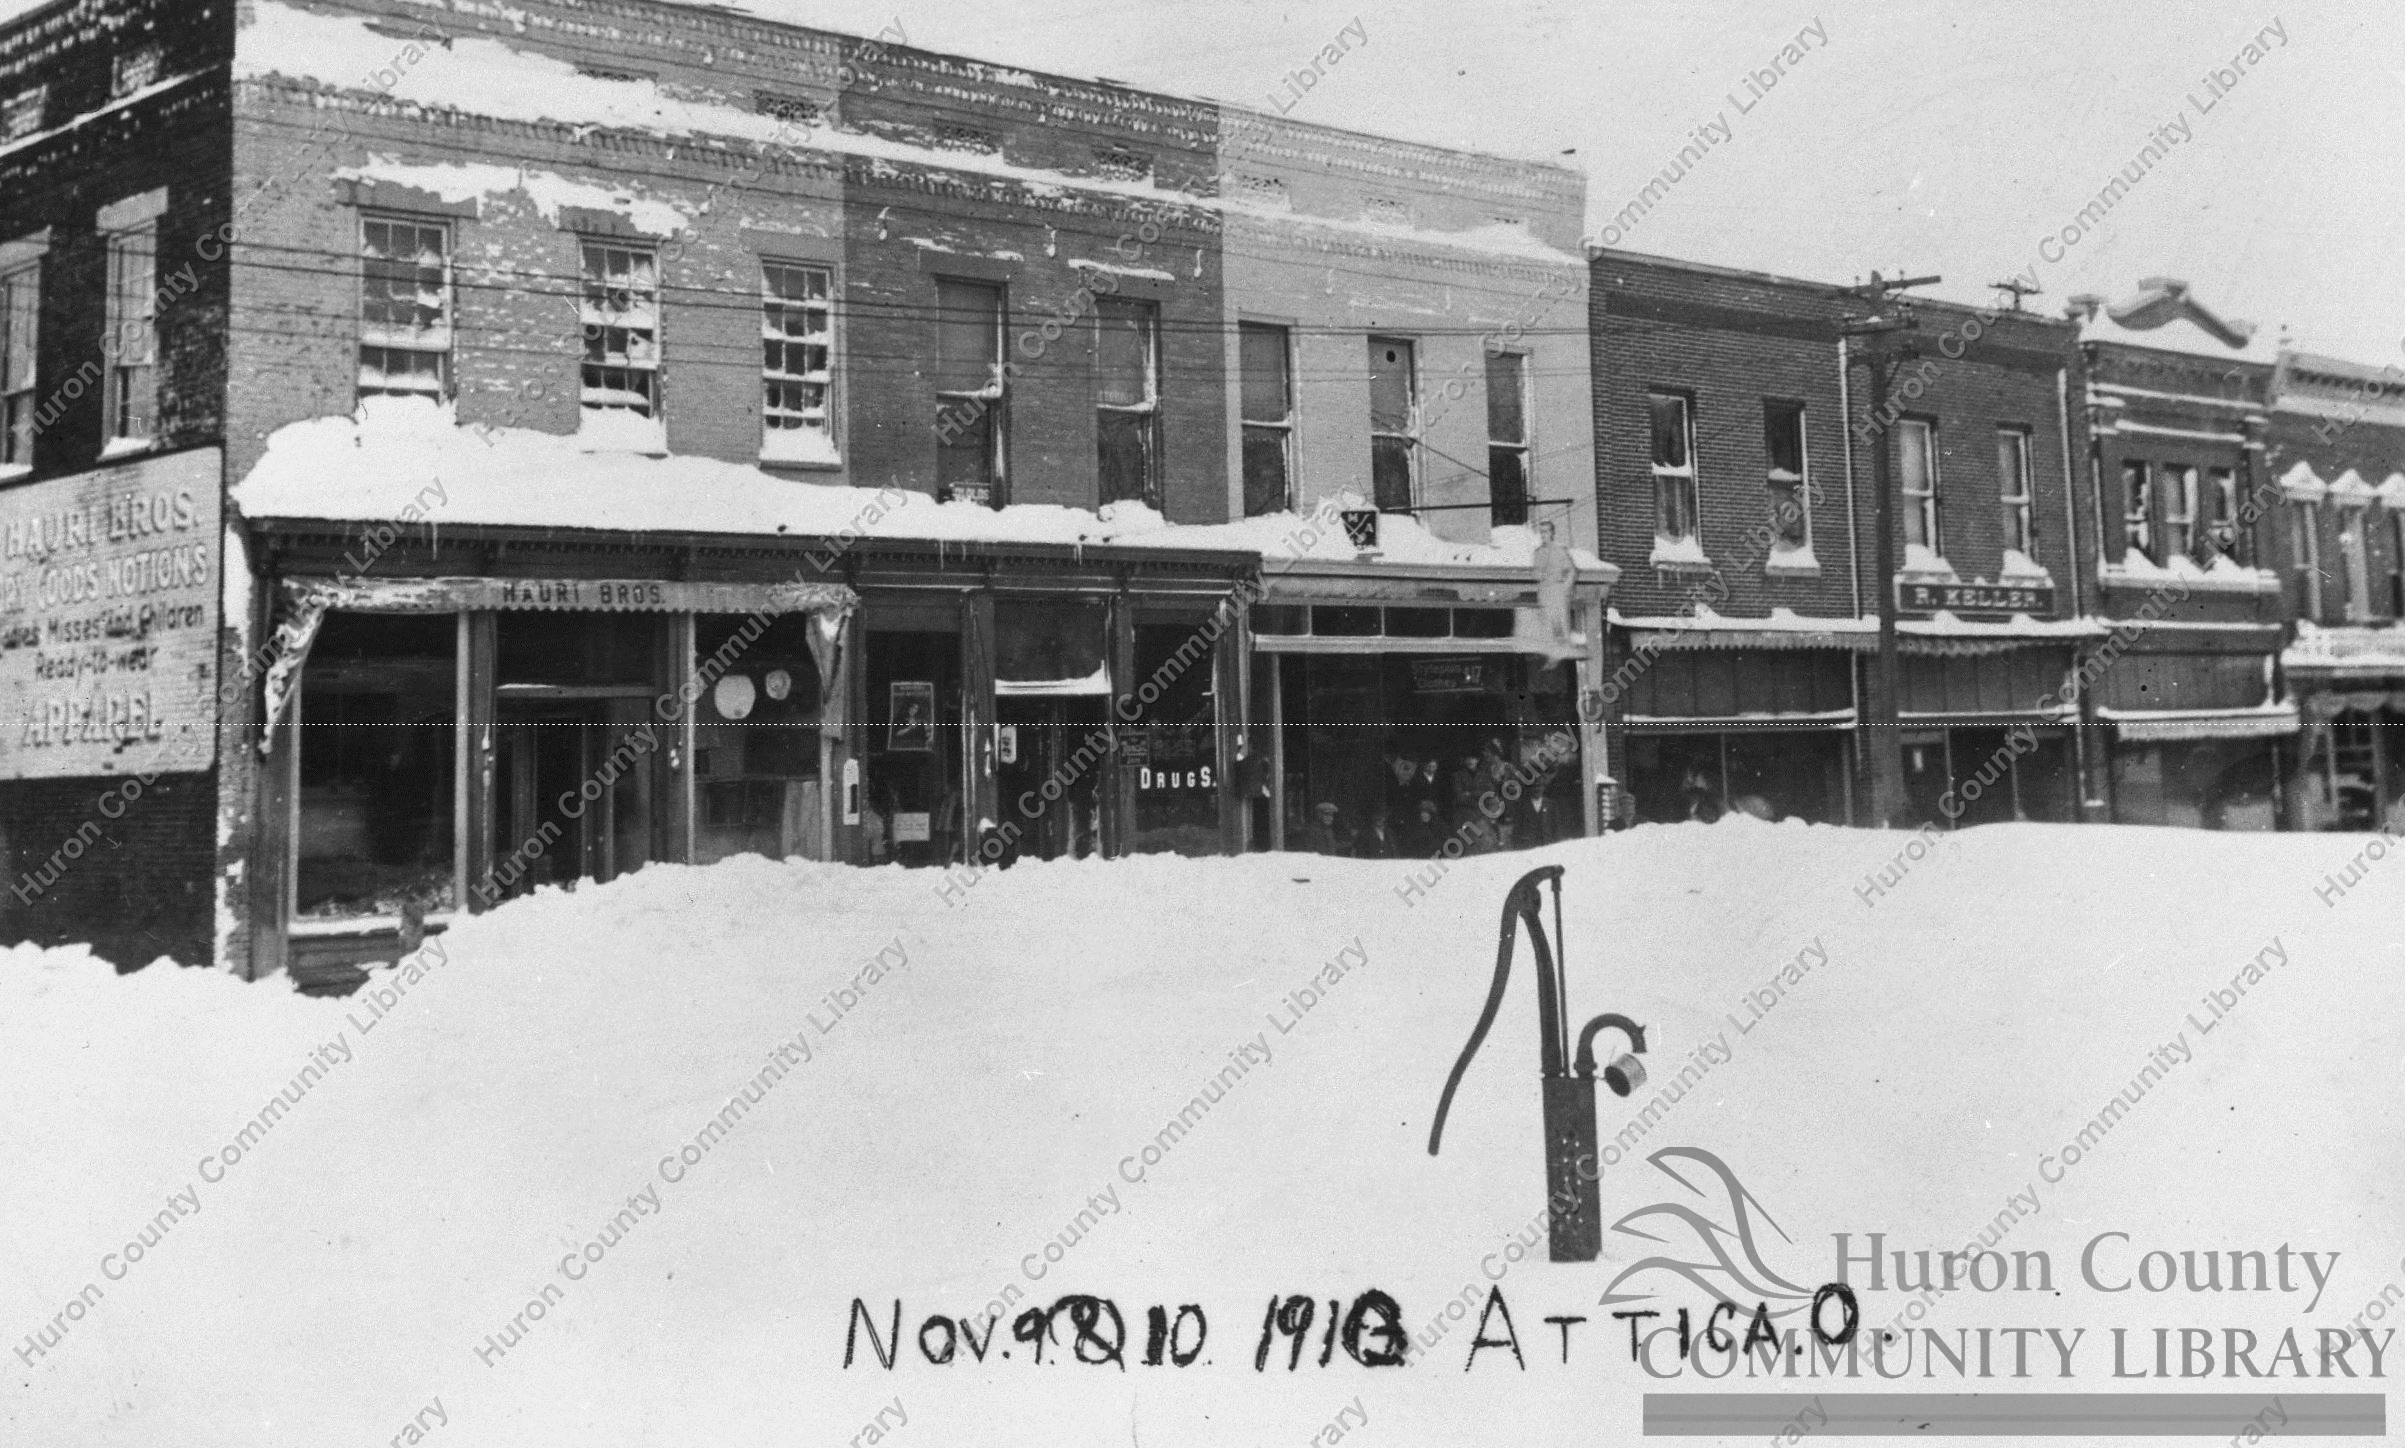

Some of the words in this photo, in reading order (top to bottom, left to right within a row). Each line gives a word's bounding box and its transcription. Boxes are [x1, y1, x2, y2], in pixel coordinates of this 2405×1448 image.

[106, 543, 207, 598] NOTIONS
[503, 582, 580, 604] HAURI
[600, 584, 667, 606] BROS.
[843, 1297, 1011, 1371] Nov.
